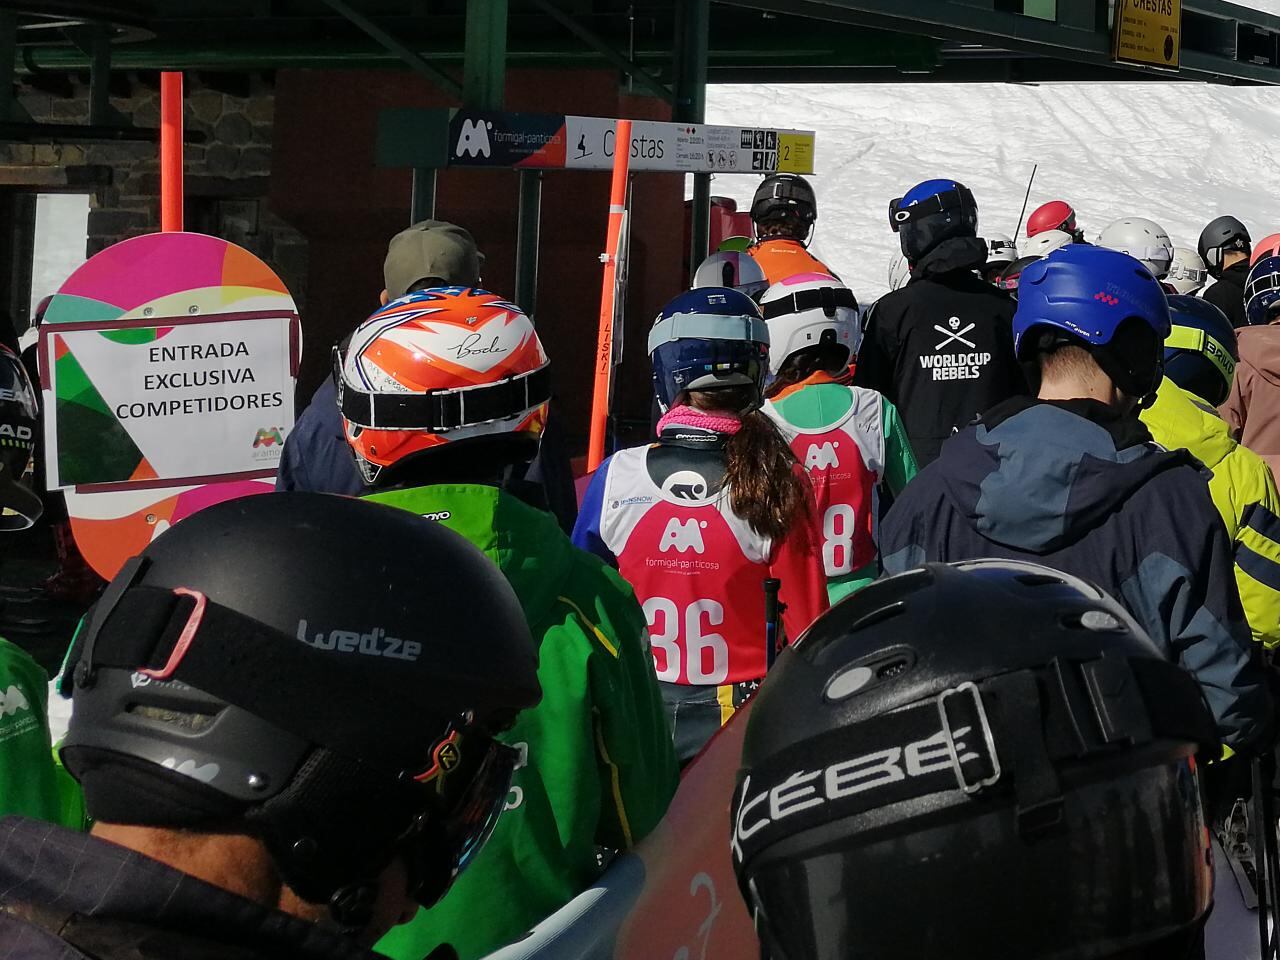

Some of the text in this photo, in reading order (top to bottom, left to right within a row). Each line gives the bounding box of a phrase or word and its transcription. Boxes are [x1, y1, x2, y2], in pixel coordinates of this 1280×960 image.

[603, 130, 664, 160] Cstas
[149, 341, 249, 363] ENTRADA
[919, 352, 992, 369] WORLDCUP
[144, 367, 256, 391] EXCLUSIVA
[932, 365, 980, 381] REBELS
[116, 392, 283, 419] COMPETIDORES
[645, 557, 720, 571] formigal-panticosa
[642, 596, 729, 686] 36
